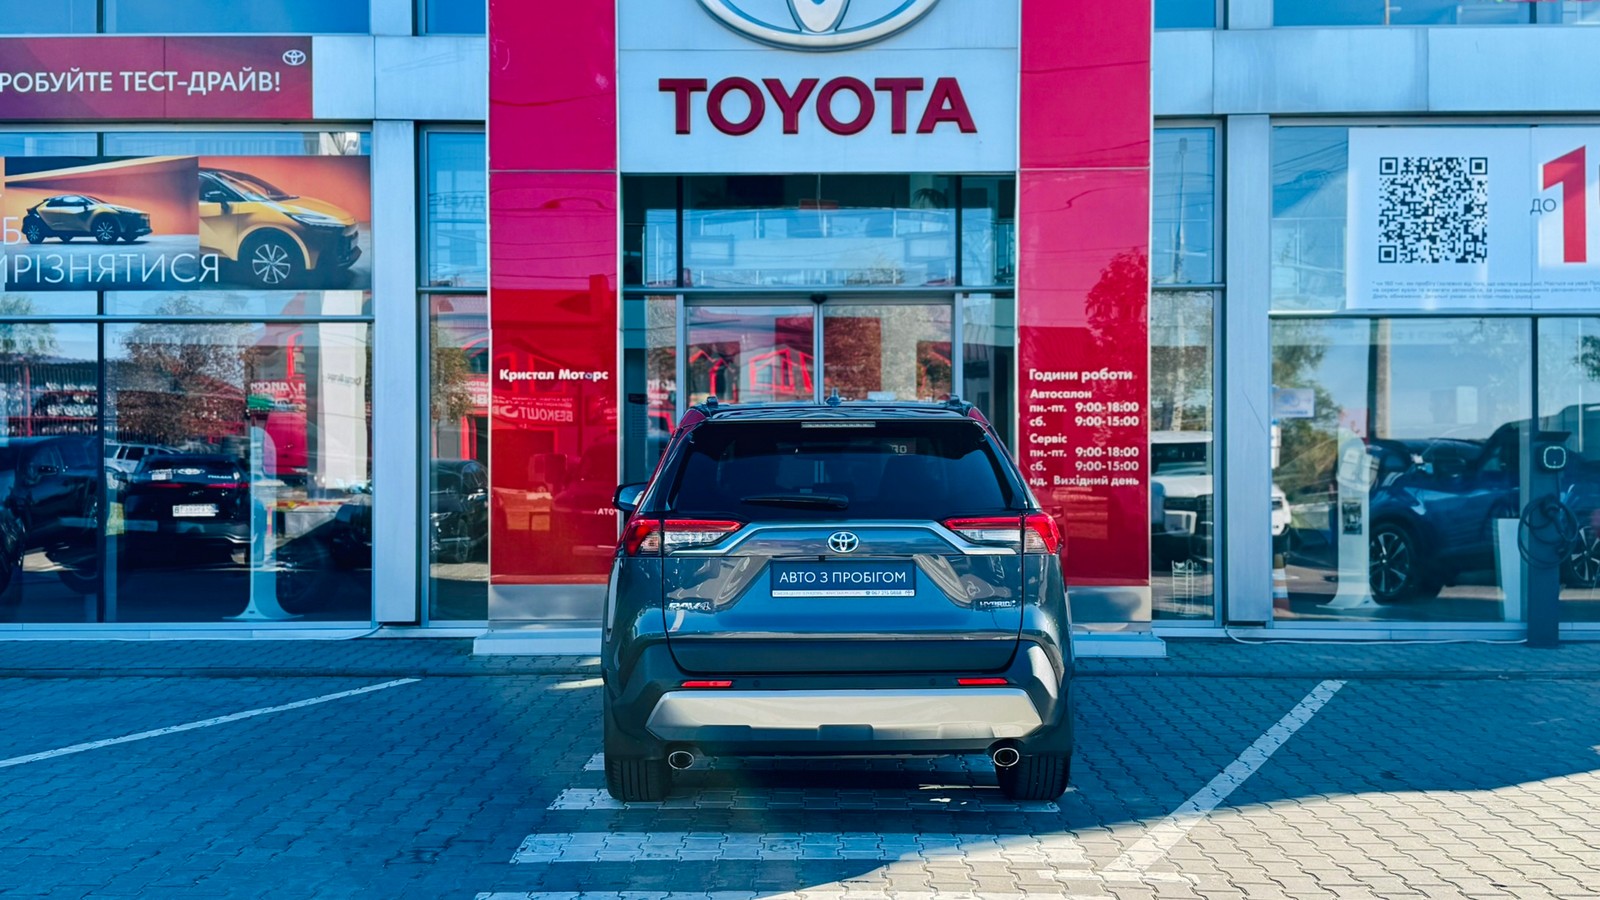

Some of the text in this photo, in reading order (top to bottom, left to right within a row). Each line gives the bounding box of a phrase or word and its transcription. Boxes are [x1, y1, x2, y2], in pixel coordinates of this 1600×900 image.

[119, 66, 281, 95] ТЕСТ-ДРАЙВ!
[658, 76, 977, 136] TOYOTA
[1530, 198, 1557, 216] ДО
[499, 369, 609, 382] Кристал Моторс
[1029, 367, 1133, 384] Години роботи
[1029, 389, 1092, 399] Автосалон
[1029, 402, 1139, 413] пн.-пт. 9:00-18:00
[1029, 416, 1139, 427] сб. 9:00-15:00
[1029, 433, 1068, 445] Сервіс
[1029, 447, 1139, 458] пн.-пт. 9:00-18:00
[1029, 461, 1139, 471] сб. 9:00-15:00
[1029, 475, 1139, 487] нд. Вихідний день
[779, 571, 906, 583] АВТО З ПРОБІГОМ
[668, 602, 711, 611] RAV4
